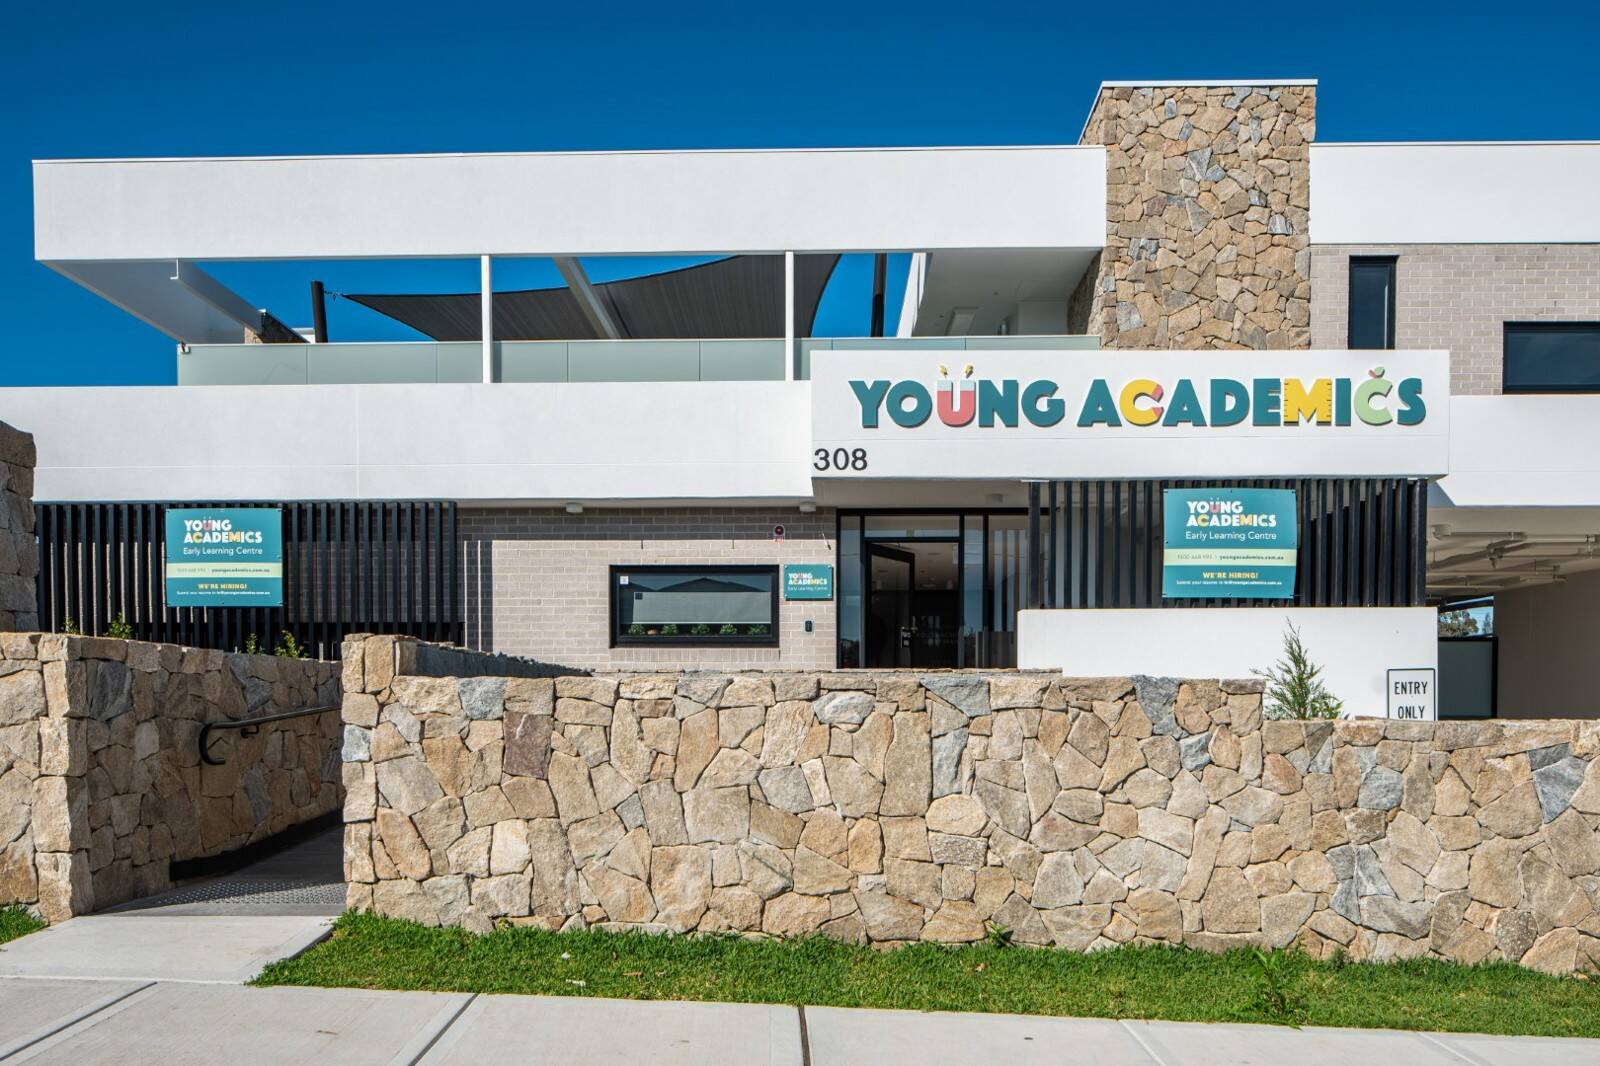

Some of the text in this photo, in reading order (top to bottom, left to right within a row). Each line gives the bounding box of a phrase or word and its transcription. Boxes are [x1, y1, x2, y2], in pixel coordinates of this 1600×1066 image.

[848, 378, 1427, 429] YOUNG ACADEMICS
[813, 448, 868, 472] 308
[1186, 500, 1243, 514] YOUNG
[183, 518, 232, 532] YOUNG
[1186, 514, 1277, 528] ACADEMICS
[183, 531, 263, 544] ACADEMICS
[1185, 531, 1277, 541] Early Learning Centre
[183, 546, 263, 556] Early Learning Centre
[1203, 571, 1259, 579] WE'RE HIRING!
[1394, 681, 1428, 695] ENTRY
[1397, 705, 1425, 719] ONLY
